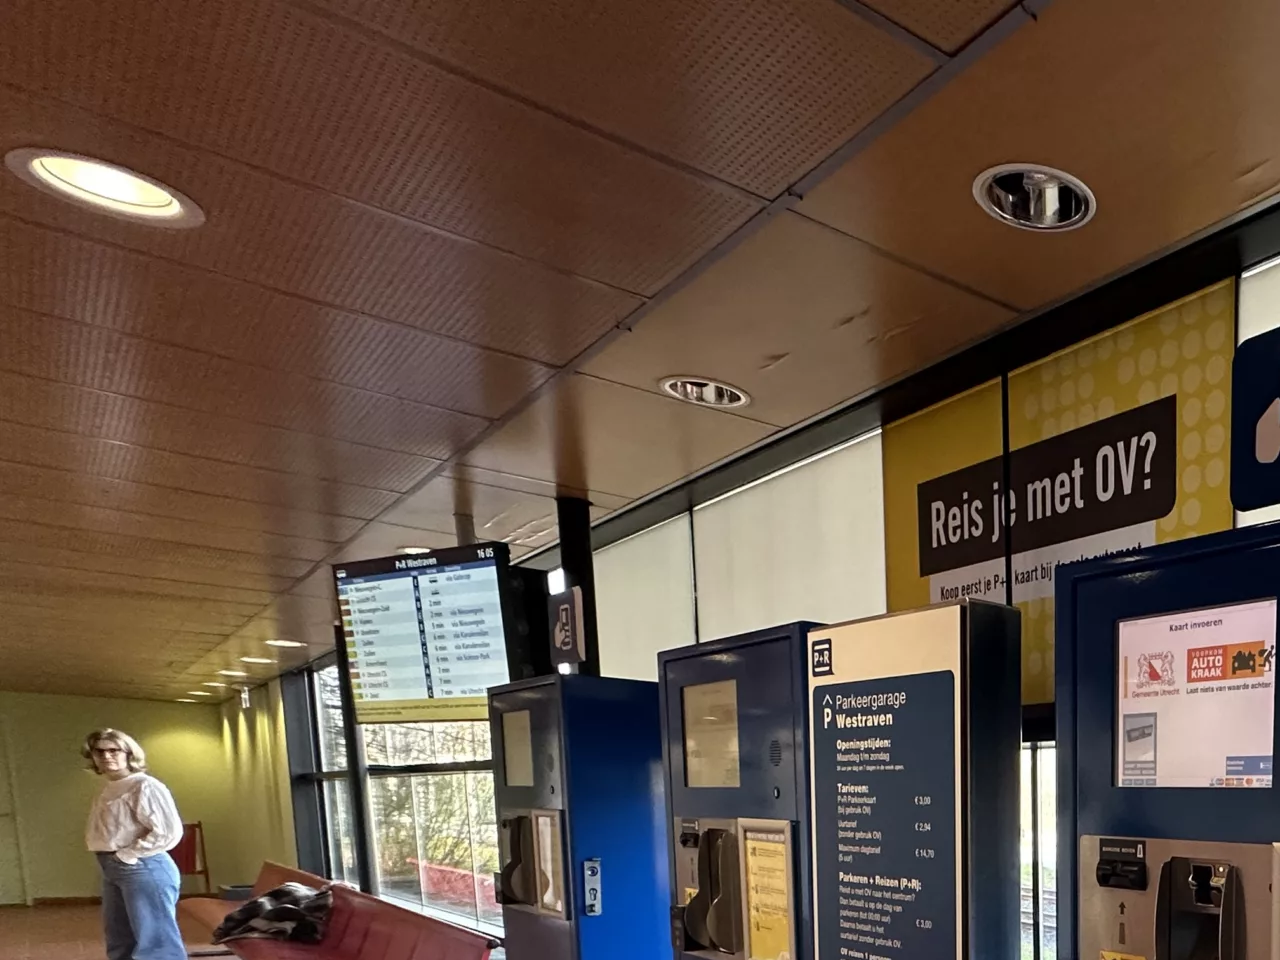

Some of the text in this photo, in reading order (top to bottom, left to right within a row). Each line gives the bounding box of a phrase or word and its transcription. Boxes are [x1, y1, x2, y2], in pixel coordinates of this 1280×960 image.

[931, 431, 1157, 548] Reis je met OV?
[407, 558, 437, 569] Westraven
[940, 562, 1052, 601] Koop eerst je P+ kaart bij
[1169, 619, 1223, 632] Kaart invoeren
[814, 651, 830, 665] P+R
[1191, 656, 1223, 669] AUTO
[1191, 667, 1222, 679] KRAAK
[1132, 689, 1180, 699] Gemeente Utrecht
[1186, 686, 1199, 694] Laat
[1251, 682, 1272, 690] achter.
[836, 692, 906, 710] Parkeergarage
[823, 708, 831, 729] P
[836, 713, 893, 729] Westraven
[836, 738, 891, 751] Openingstijden:
[837, 753, 859, 763] Maandag
[837, 783, 868, 793] Tarieven:
[915, 796, 931, 806] € 3,00
[839, 872, 868, 884] Parkeren
[875, 875, 898, 888] Reizen
[900, 876, 922, 890] (P+R):
